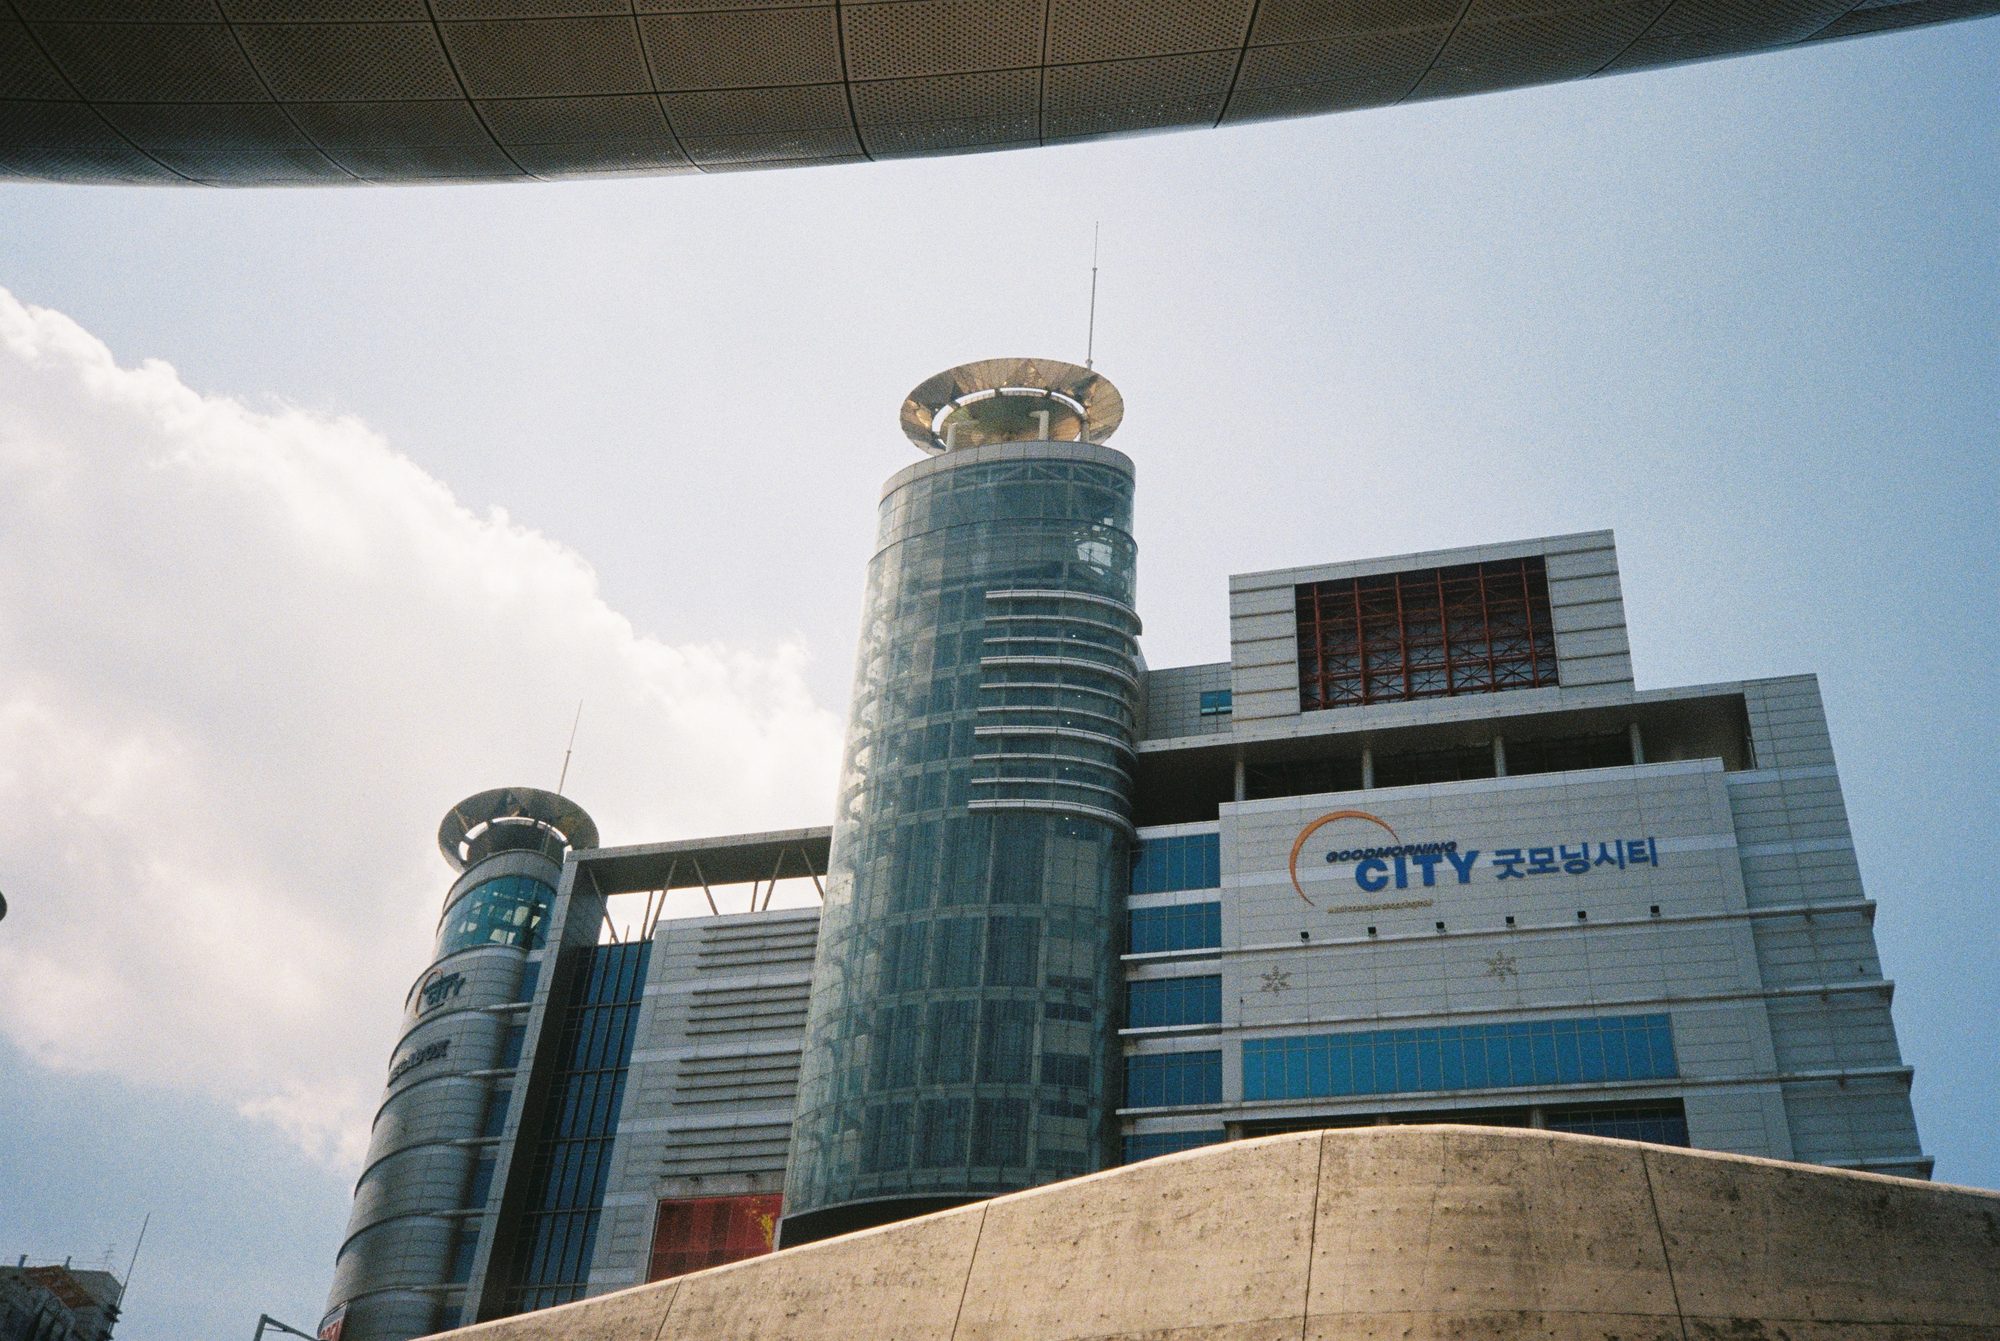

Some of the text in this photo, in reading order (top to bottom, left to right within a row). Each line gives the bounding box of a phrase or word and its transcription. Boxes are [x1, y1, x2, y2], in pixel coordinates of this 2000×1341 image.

[1326, 841, 1457, 863] GOODMORNING
[1355, 836, 1658, 892] CITY 굿모닝시티
